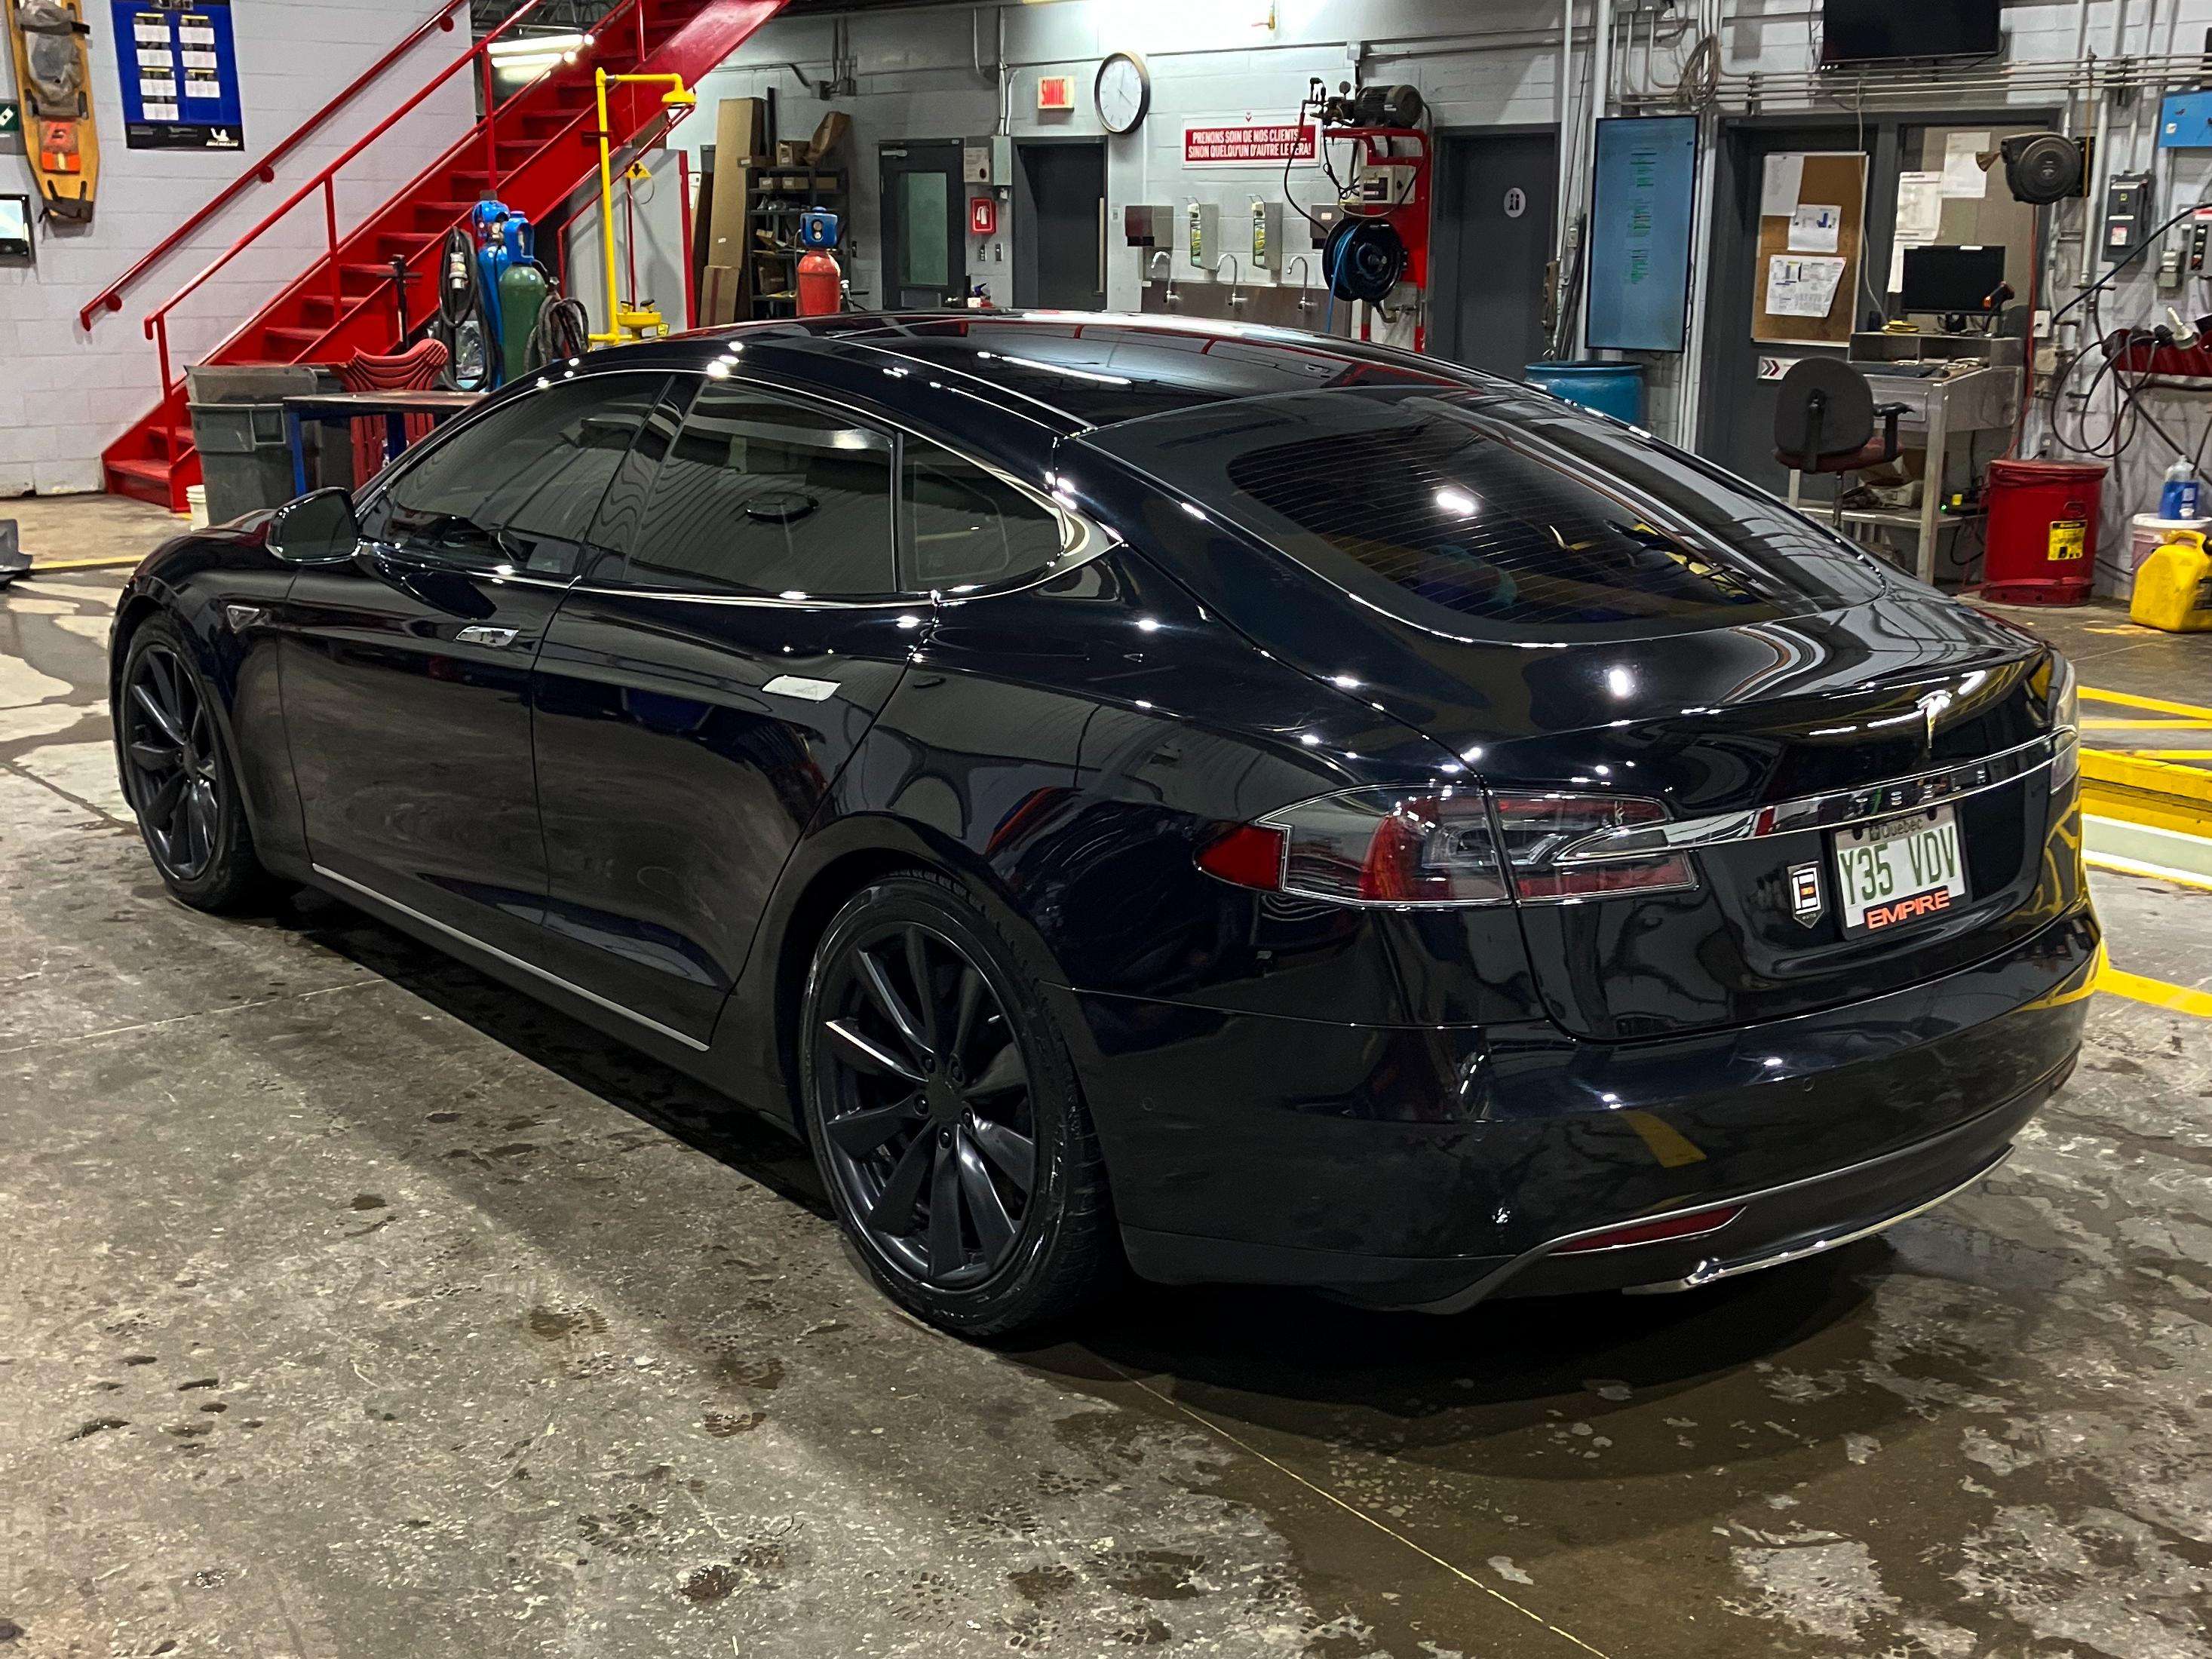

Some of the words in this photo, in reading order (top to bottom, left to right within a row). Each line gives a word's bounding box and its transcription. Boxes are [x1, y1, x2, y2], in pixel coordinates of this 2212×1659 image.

[1188, 145, 1210, 158] SINON
[1210, 144, 1250, 158] QUELQU'UN
[1250, 143, 1279, 157] D'AUTRE
[1280, 143, 1290, 156] LE
[1192, 130, 1224, 144] PRENONS
[1225, 130, 1242, 143] SOIN
[1242, 130, 1253, 143] DE
[1253, 129, 1269, 143] NOS
[1839, 842, 1894, 905] Y35
[1908, 826, 1956, 887] VDV
[1867, 888, 1950, 930] EMPIRE
